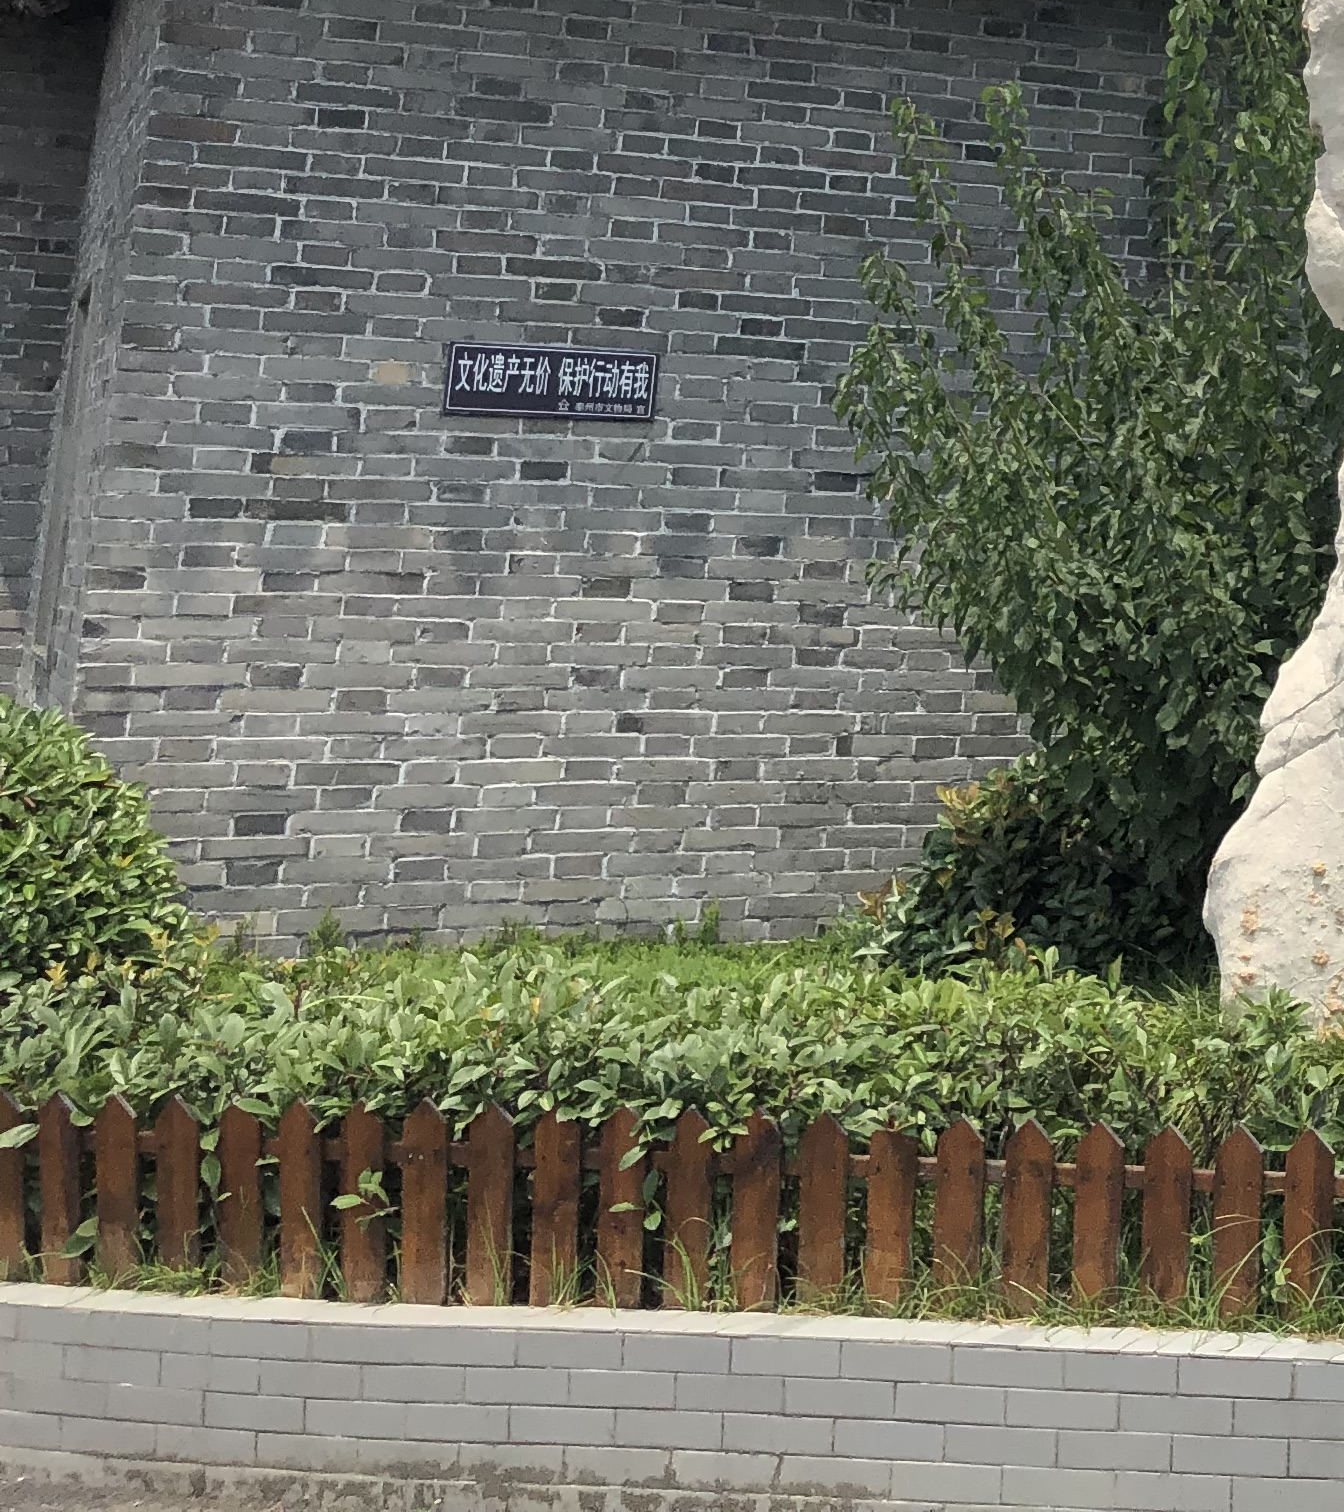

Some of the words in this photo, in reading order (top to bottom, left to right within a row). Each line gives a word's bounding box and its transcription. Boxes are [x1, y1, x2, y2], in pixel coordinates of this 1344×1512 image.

[455, 351, 551, 396] 文化遗产无价
[558, 356, 650, 399] 保护行动有我
